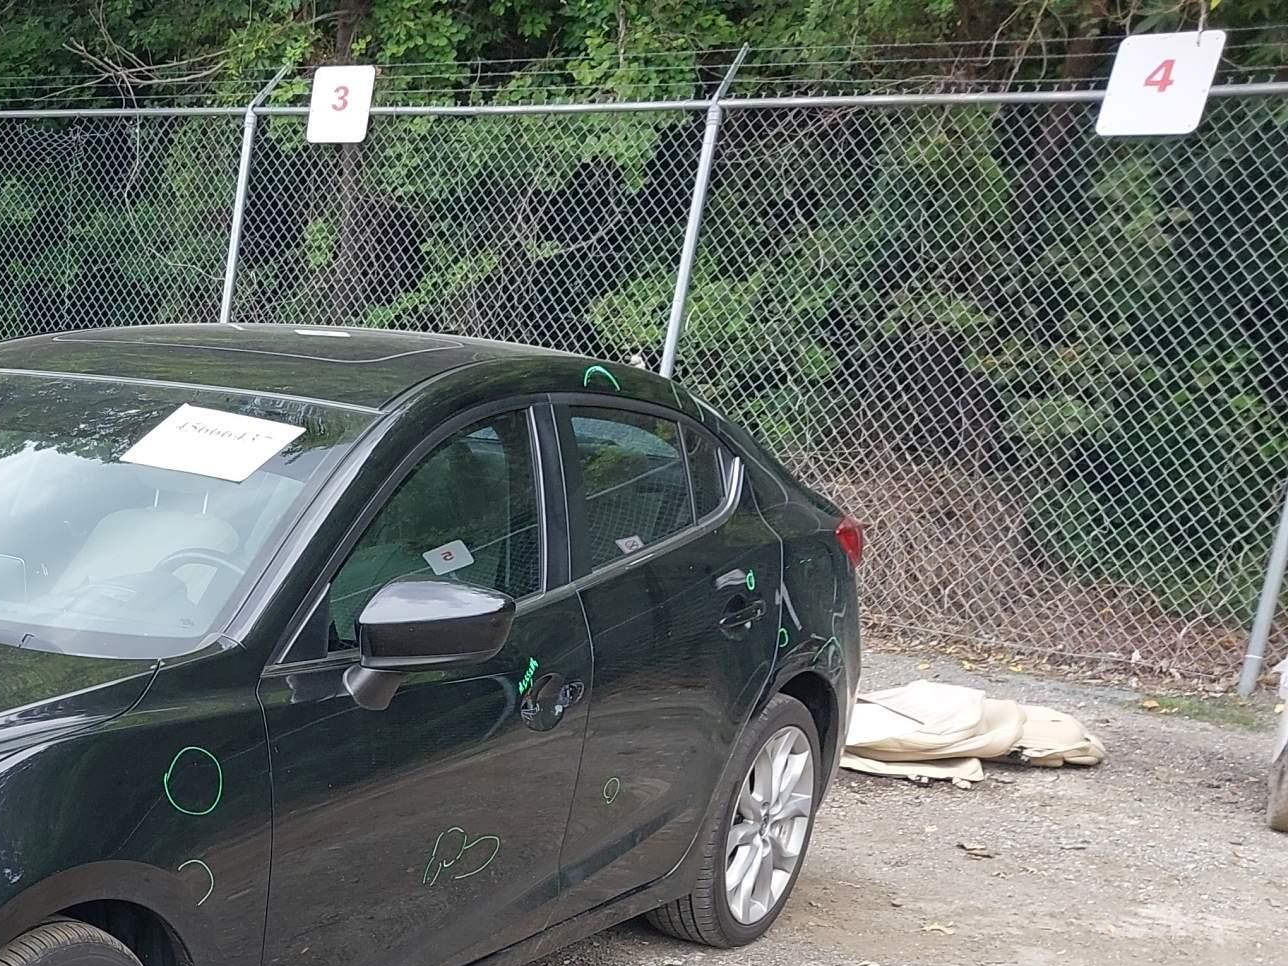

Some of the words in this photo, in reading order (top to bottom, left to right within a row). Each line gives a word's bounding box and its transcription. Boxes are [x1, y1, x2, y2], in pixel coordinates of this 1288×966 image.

[1144, 59, 1176, 93] 4
[332, 86, 350, 111] 3
[176, 421, 274, 441] 456664
